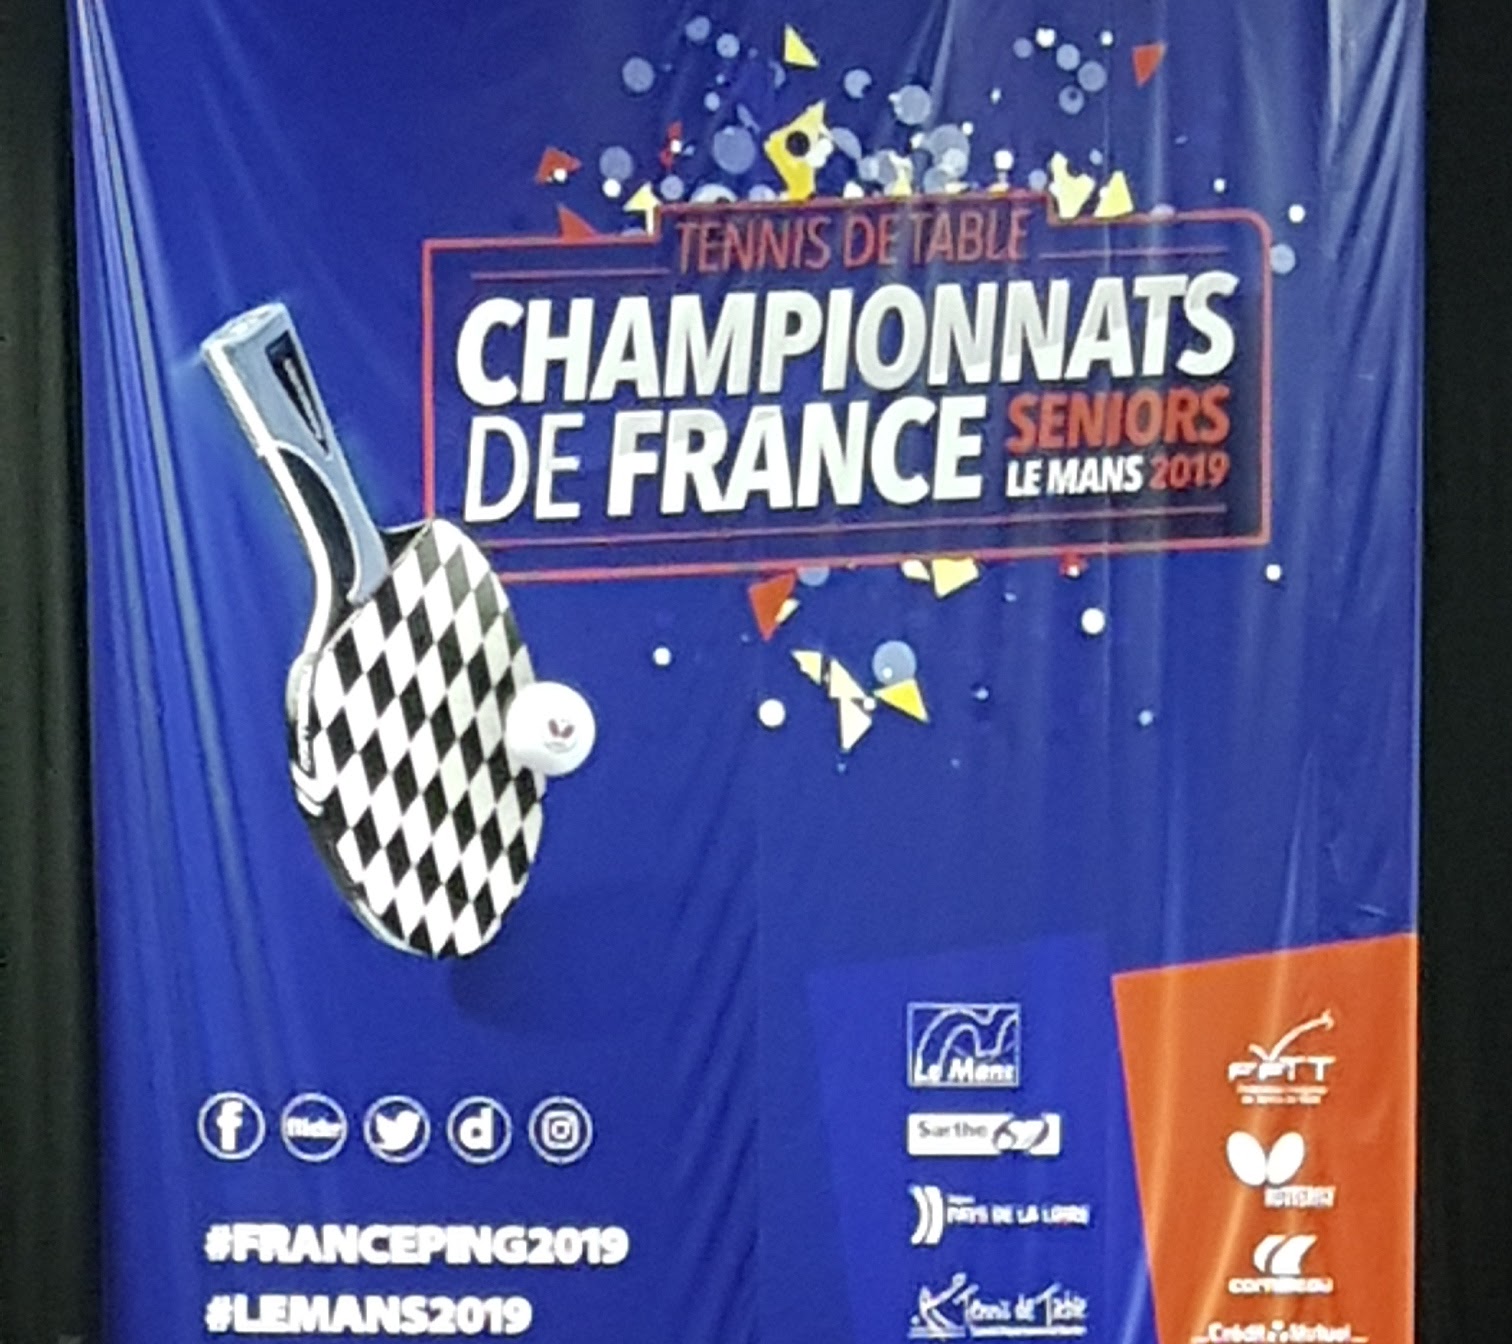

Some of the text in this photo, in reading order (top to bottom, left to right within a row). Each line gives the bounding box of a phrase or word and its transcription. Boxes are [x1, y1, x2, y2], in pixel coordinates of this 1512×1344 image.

[676, 209, 1033, 272] TENNIS DE TABLE
[455, 271, 1239, 407] CHAMPIONNATS
[1005, 387, 1231, 453] SENIORS
[464, 396, 988, 522] DE FRANCE
[1006, 452, 1231, 497] LE MANS 2019
[205, 1224, 630, 1265] #FRANCEPING2019
[205, 1295, 534, 1334] #LEMANS2019
